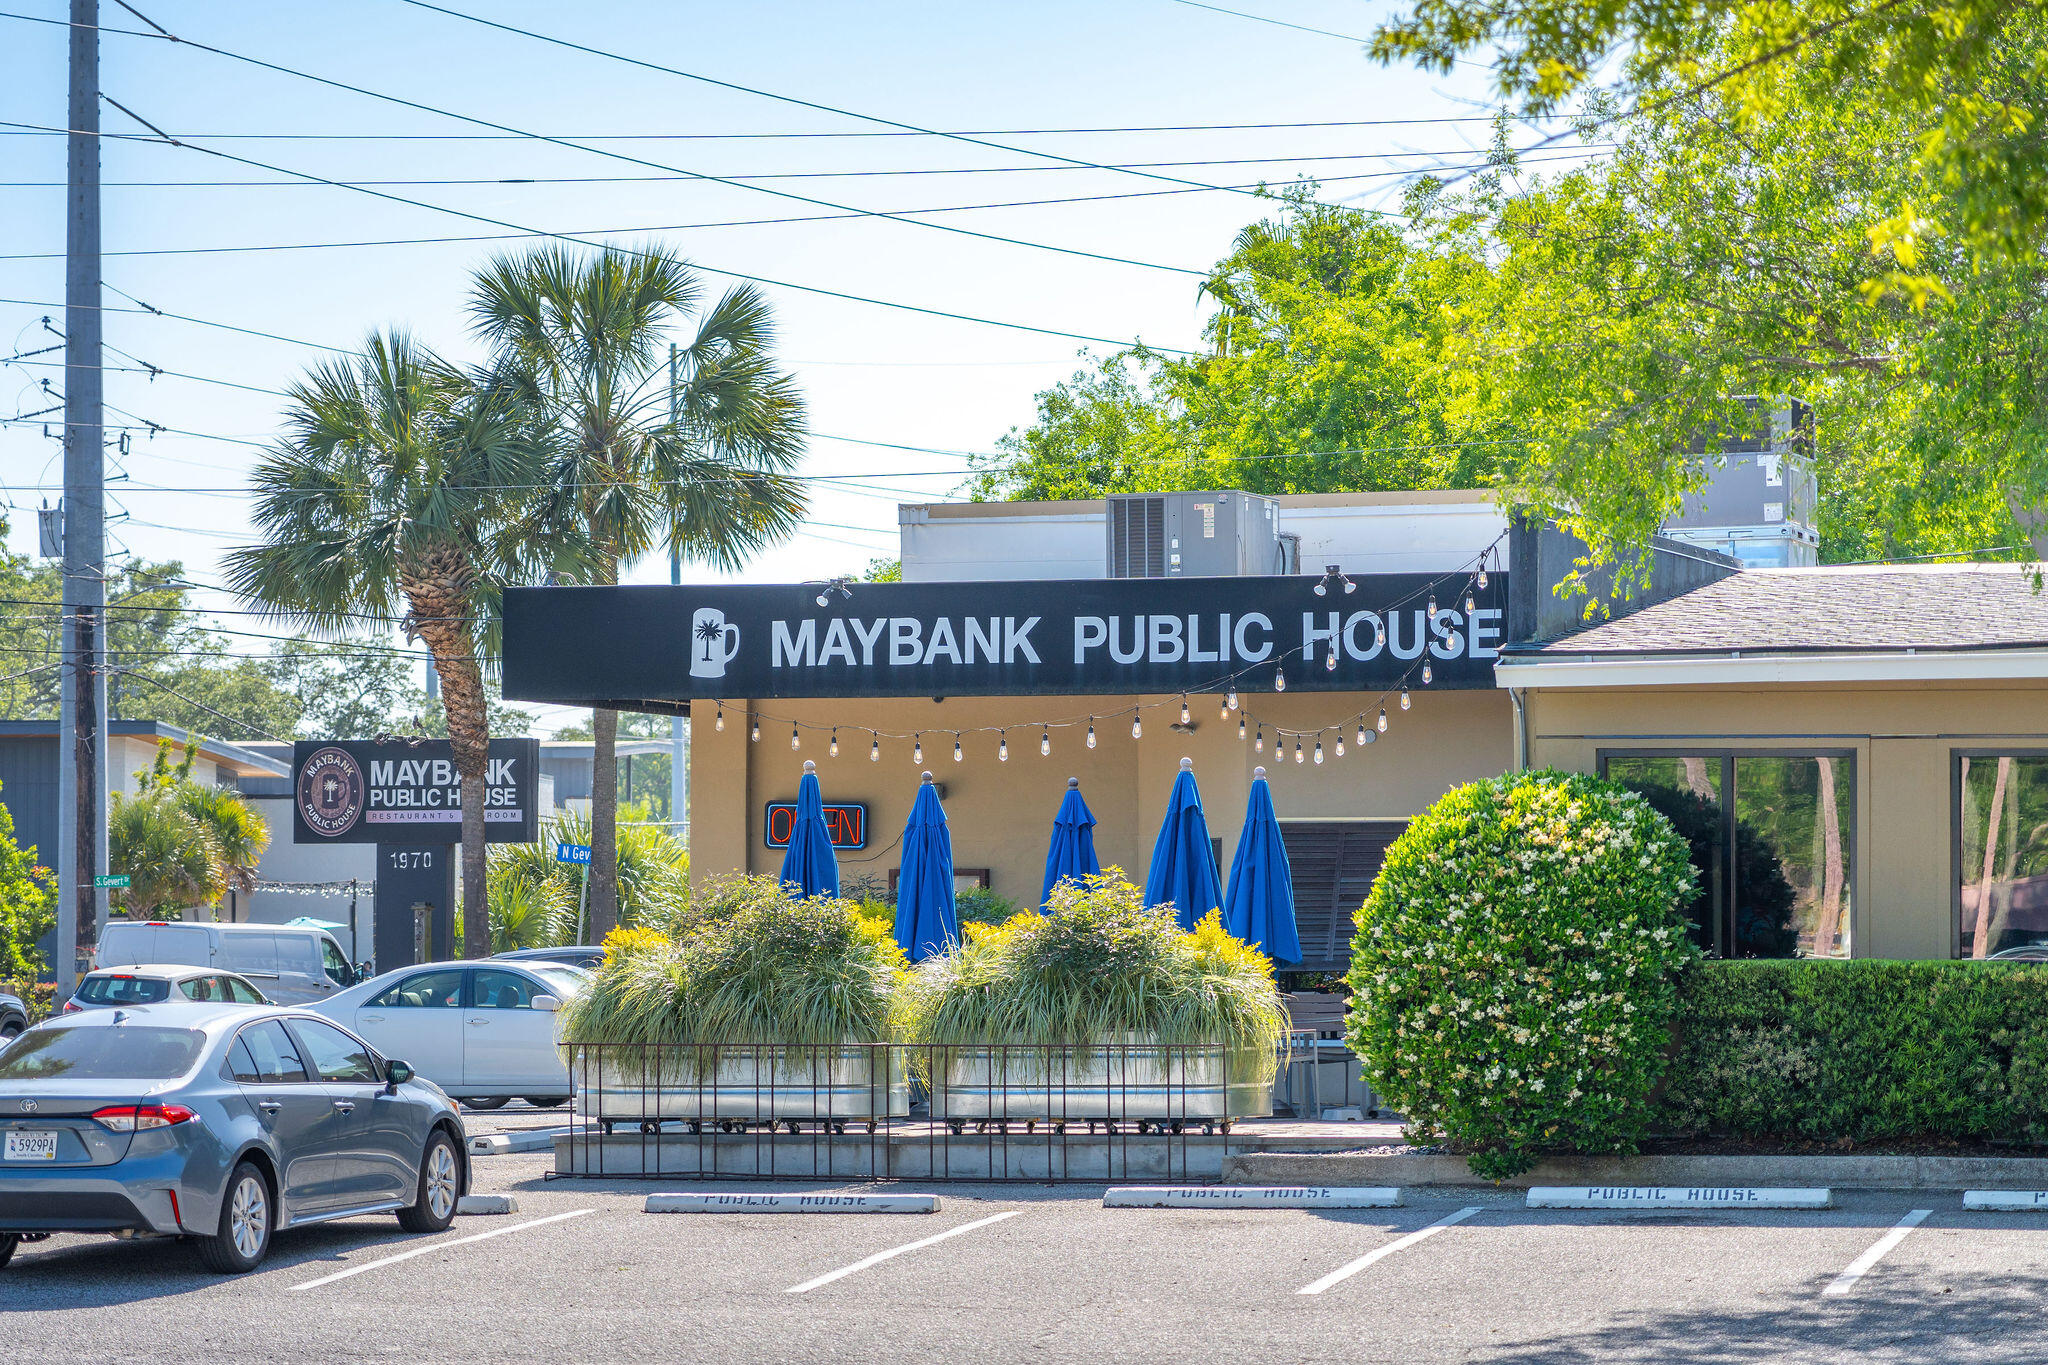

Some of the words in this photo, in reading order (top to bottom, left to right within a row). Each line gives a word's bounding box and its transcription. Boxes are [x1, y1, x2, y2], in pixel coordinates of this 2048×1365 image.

[771, 616, 1042, 668] MAYBANK
[1074, 611, 1274, 665] PUBLIC
[1303, 608, 1502, 661] HOUSE
[306, 754, 355, 778] MAYBANK
[370, 758, 517, 787] MAYBNK
[370, 788, 441, 807] PUBLIC
[447, 787, 517, 806] HUSE
[305, 803, 330, 829] PUBLIC
[332, 803, 356, 829] HOUSE
[372, 812, 442, 820] RESTAURANT
[771, 808, 861, 844] ON
[390, 851, 432, 869] 1970
[562, 845, 570, 859] N
[102, 876, 124, 886] Gevert
[19, 1138, 54, 1152] 5929PA
[1587, 1188, 1666, 1200] PUBLIC
[1688, 1188, 1758, 1201] HOUSE
